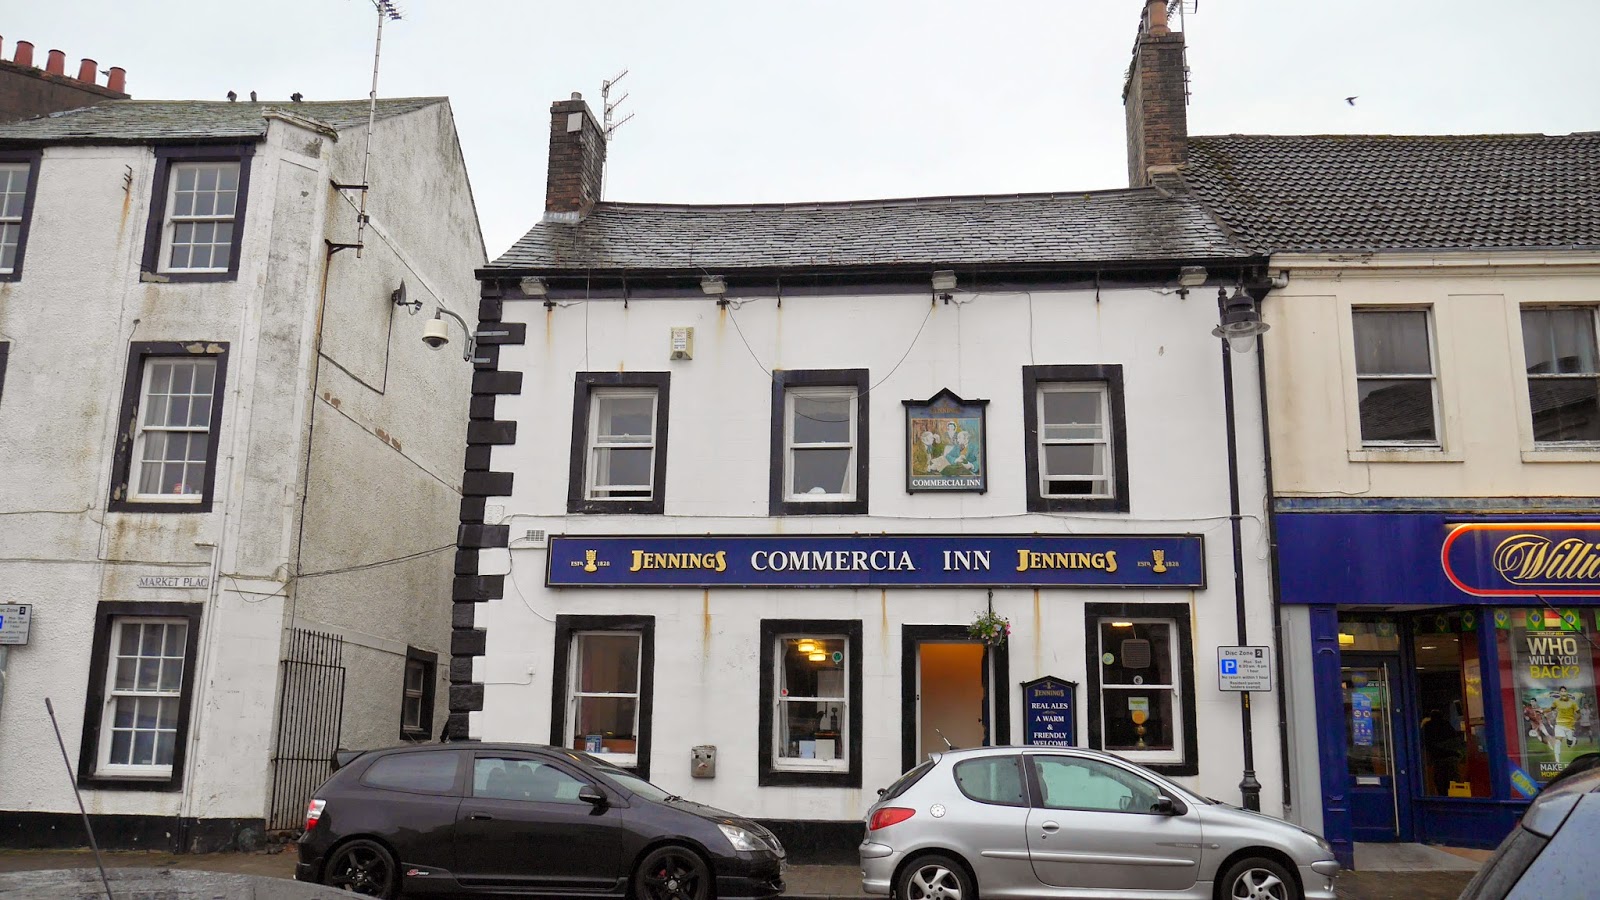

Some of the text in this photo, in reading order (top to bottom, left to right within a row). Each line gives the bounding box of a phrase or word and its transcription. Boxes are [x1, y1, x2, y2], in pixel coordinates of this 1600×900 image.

[912, 479, 965, 487] COMMERCIAL
[629, 549, 1118, 572] JENNINGS COMMERCIA INN JENNINGS
[139, 577, 209, 587] MARKET PLAC
[1526, 637, 1578, 655] WHO
[1528, 655, 1579, 665] WILL YOU
[1225, 661, 1235, 673] P
[1530, 665, 1580, 679] BACK?
[1034, 689, 1065, 697] JENNINGS
[1046, 723, 1054, 731] &
[1033, 731, 1068, 739] FRIENDLY
[1540, 763, 1563, 771] MAKE
